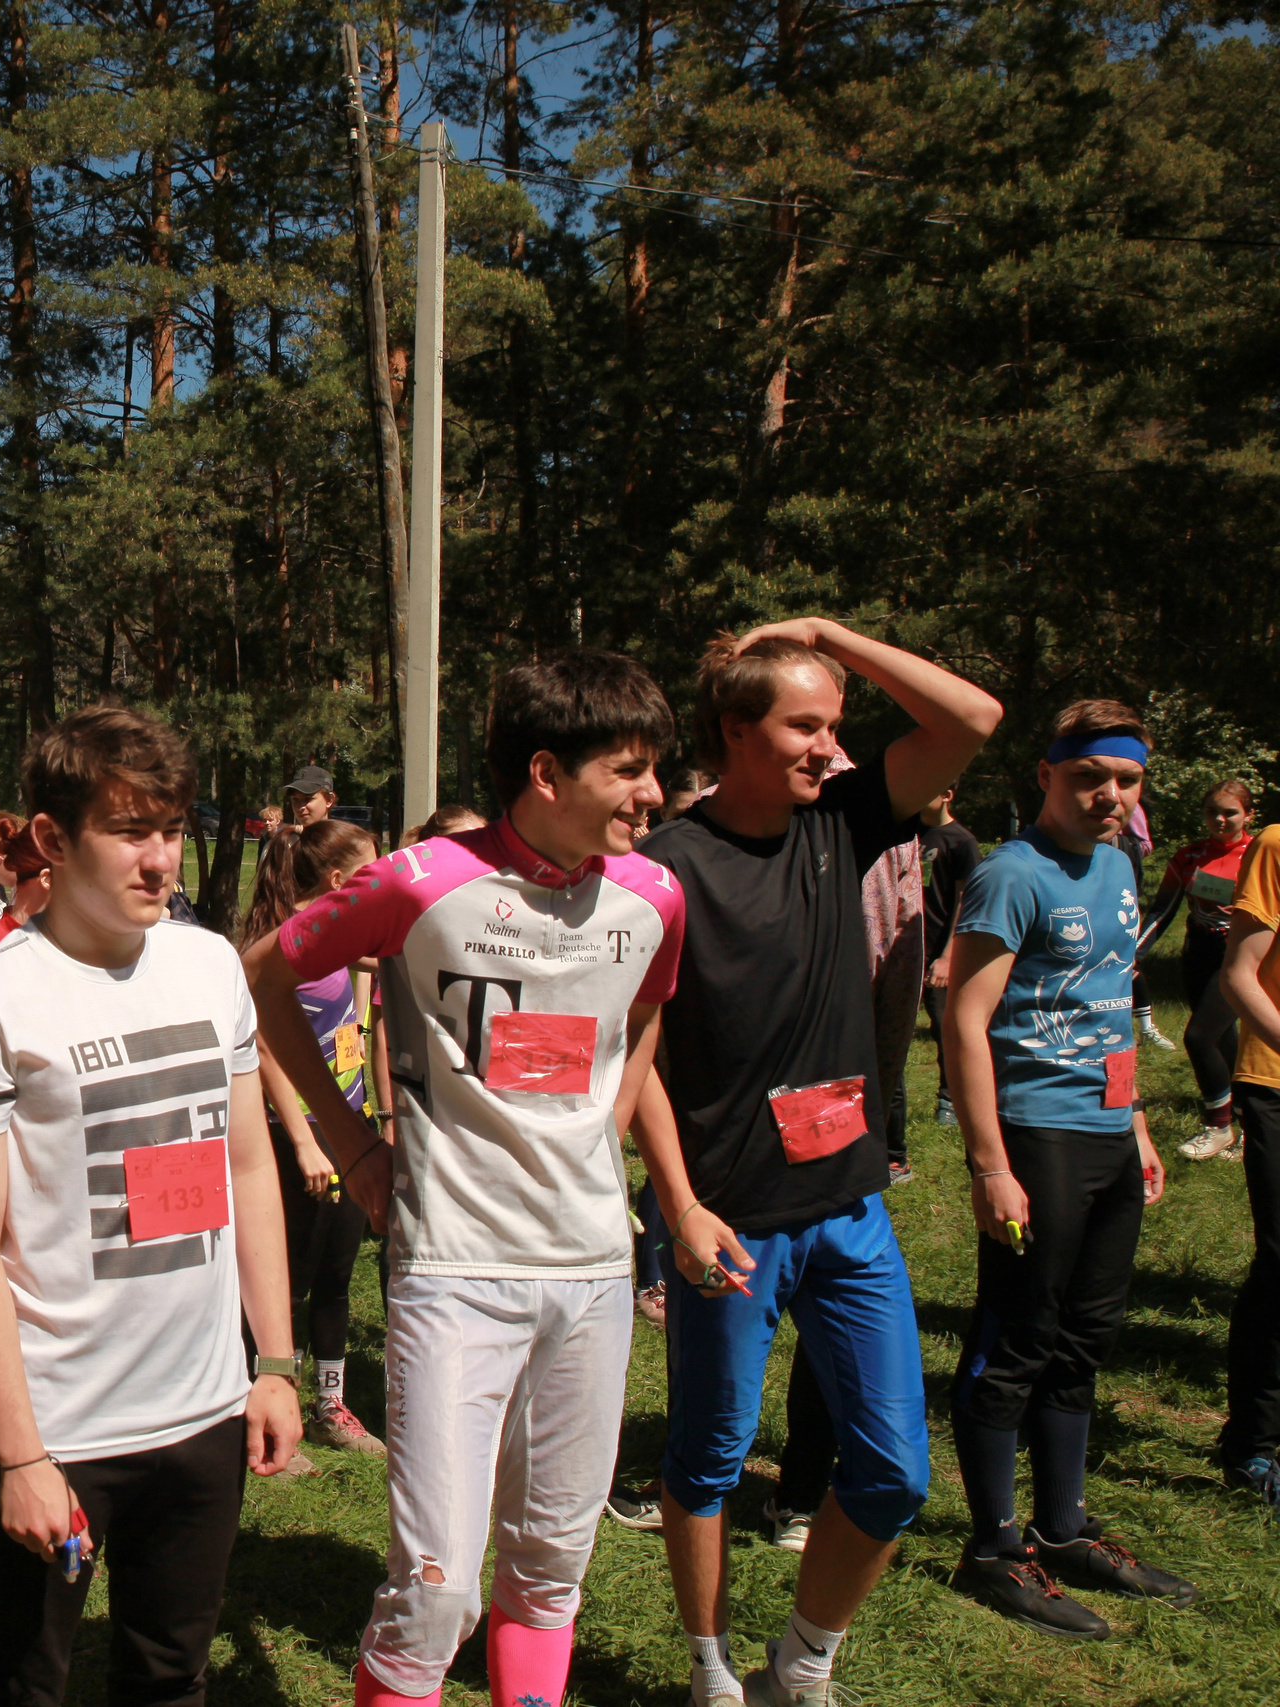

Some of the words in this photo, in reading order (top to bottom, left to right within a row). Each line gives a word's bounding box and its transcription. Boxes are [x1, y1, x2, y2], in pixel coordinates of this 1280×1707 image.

[388, 842, 431, 884] T
[1051, 906, 1086, 914] ЧЕБАРКУЛЬ
[483, 922, 522, 939] Nalini
[558, 933, 583, 942] Team
[464, 941, 536, 960] PINARELLO
[558, 943, 601, 953] Deutsche
[607, 930, 631, 964] T
[558, 954, 598, 964] Telekom
[437, 969, 522, 1084] T
[68, 1036, 124, 1075] 180
[808, 1110, 849, 1139] 135
[158, 1185, 205, 1213] 133
